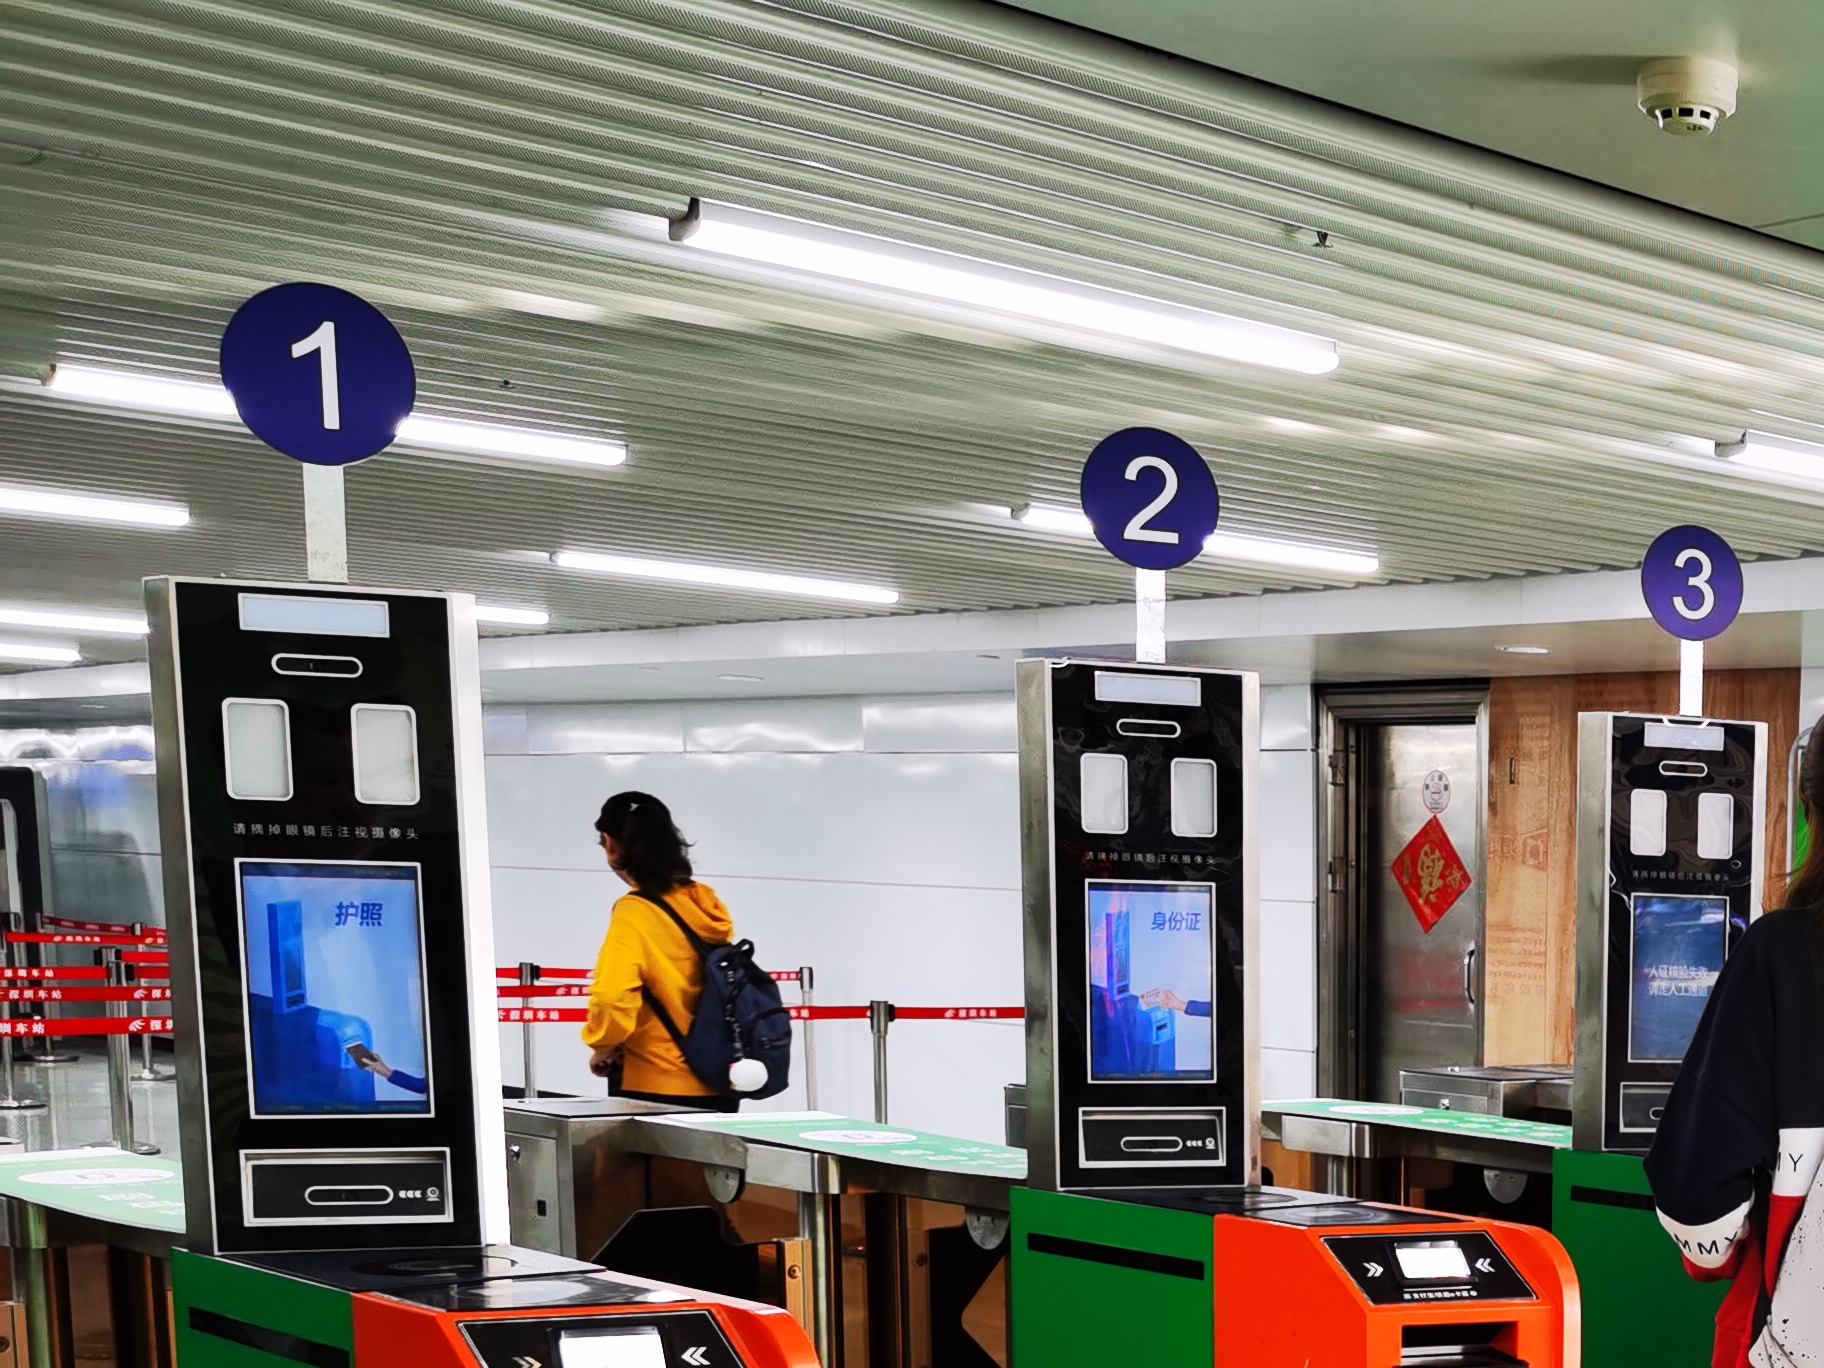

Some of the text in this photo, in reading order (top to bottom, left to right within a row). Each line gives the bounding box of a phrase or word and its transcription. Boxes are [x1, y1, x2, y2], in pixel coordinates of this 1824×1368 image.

[291, 320, 341, 431] 1
[1122, 456, 1181, 545] 2
[1672, 549, 1715, 621] 3
[232, 823, 420, 840] 请摘掉眼镜后注视摄像头
[335, 901, 384, 927] 护照
[1150, 911, 1202, 931] 身份证
